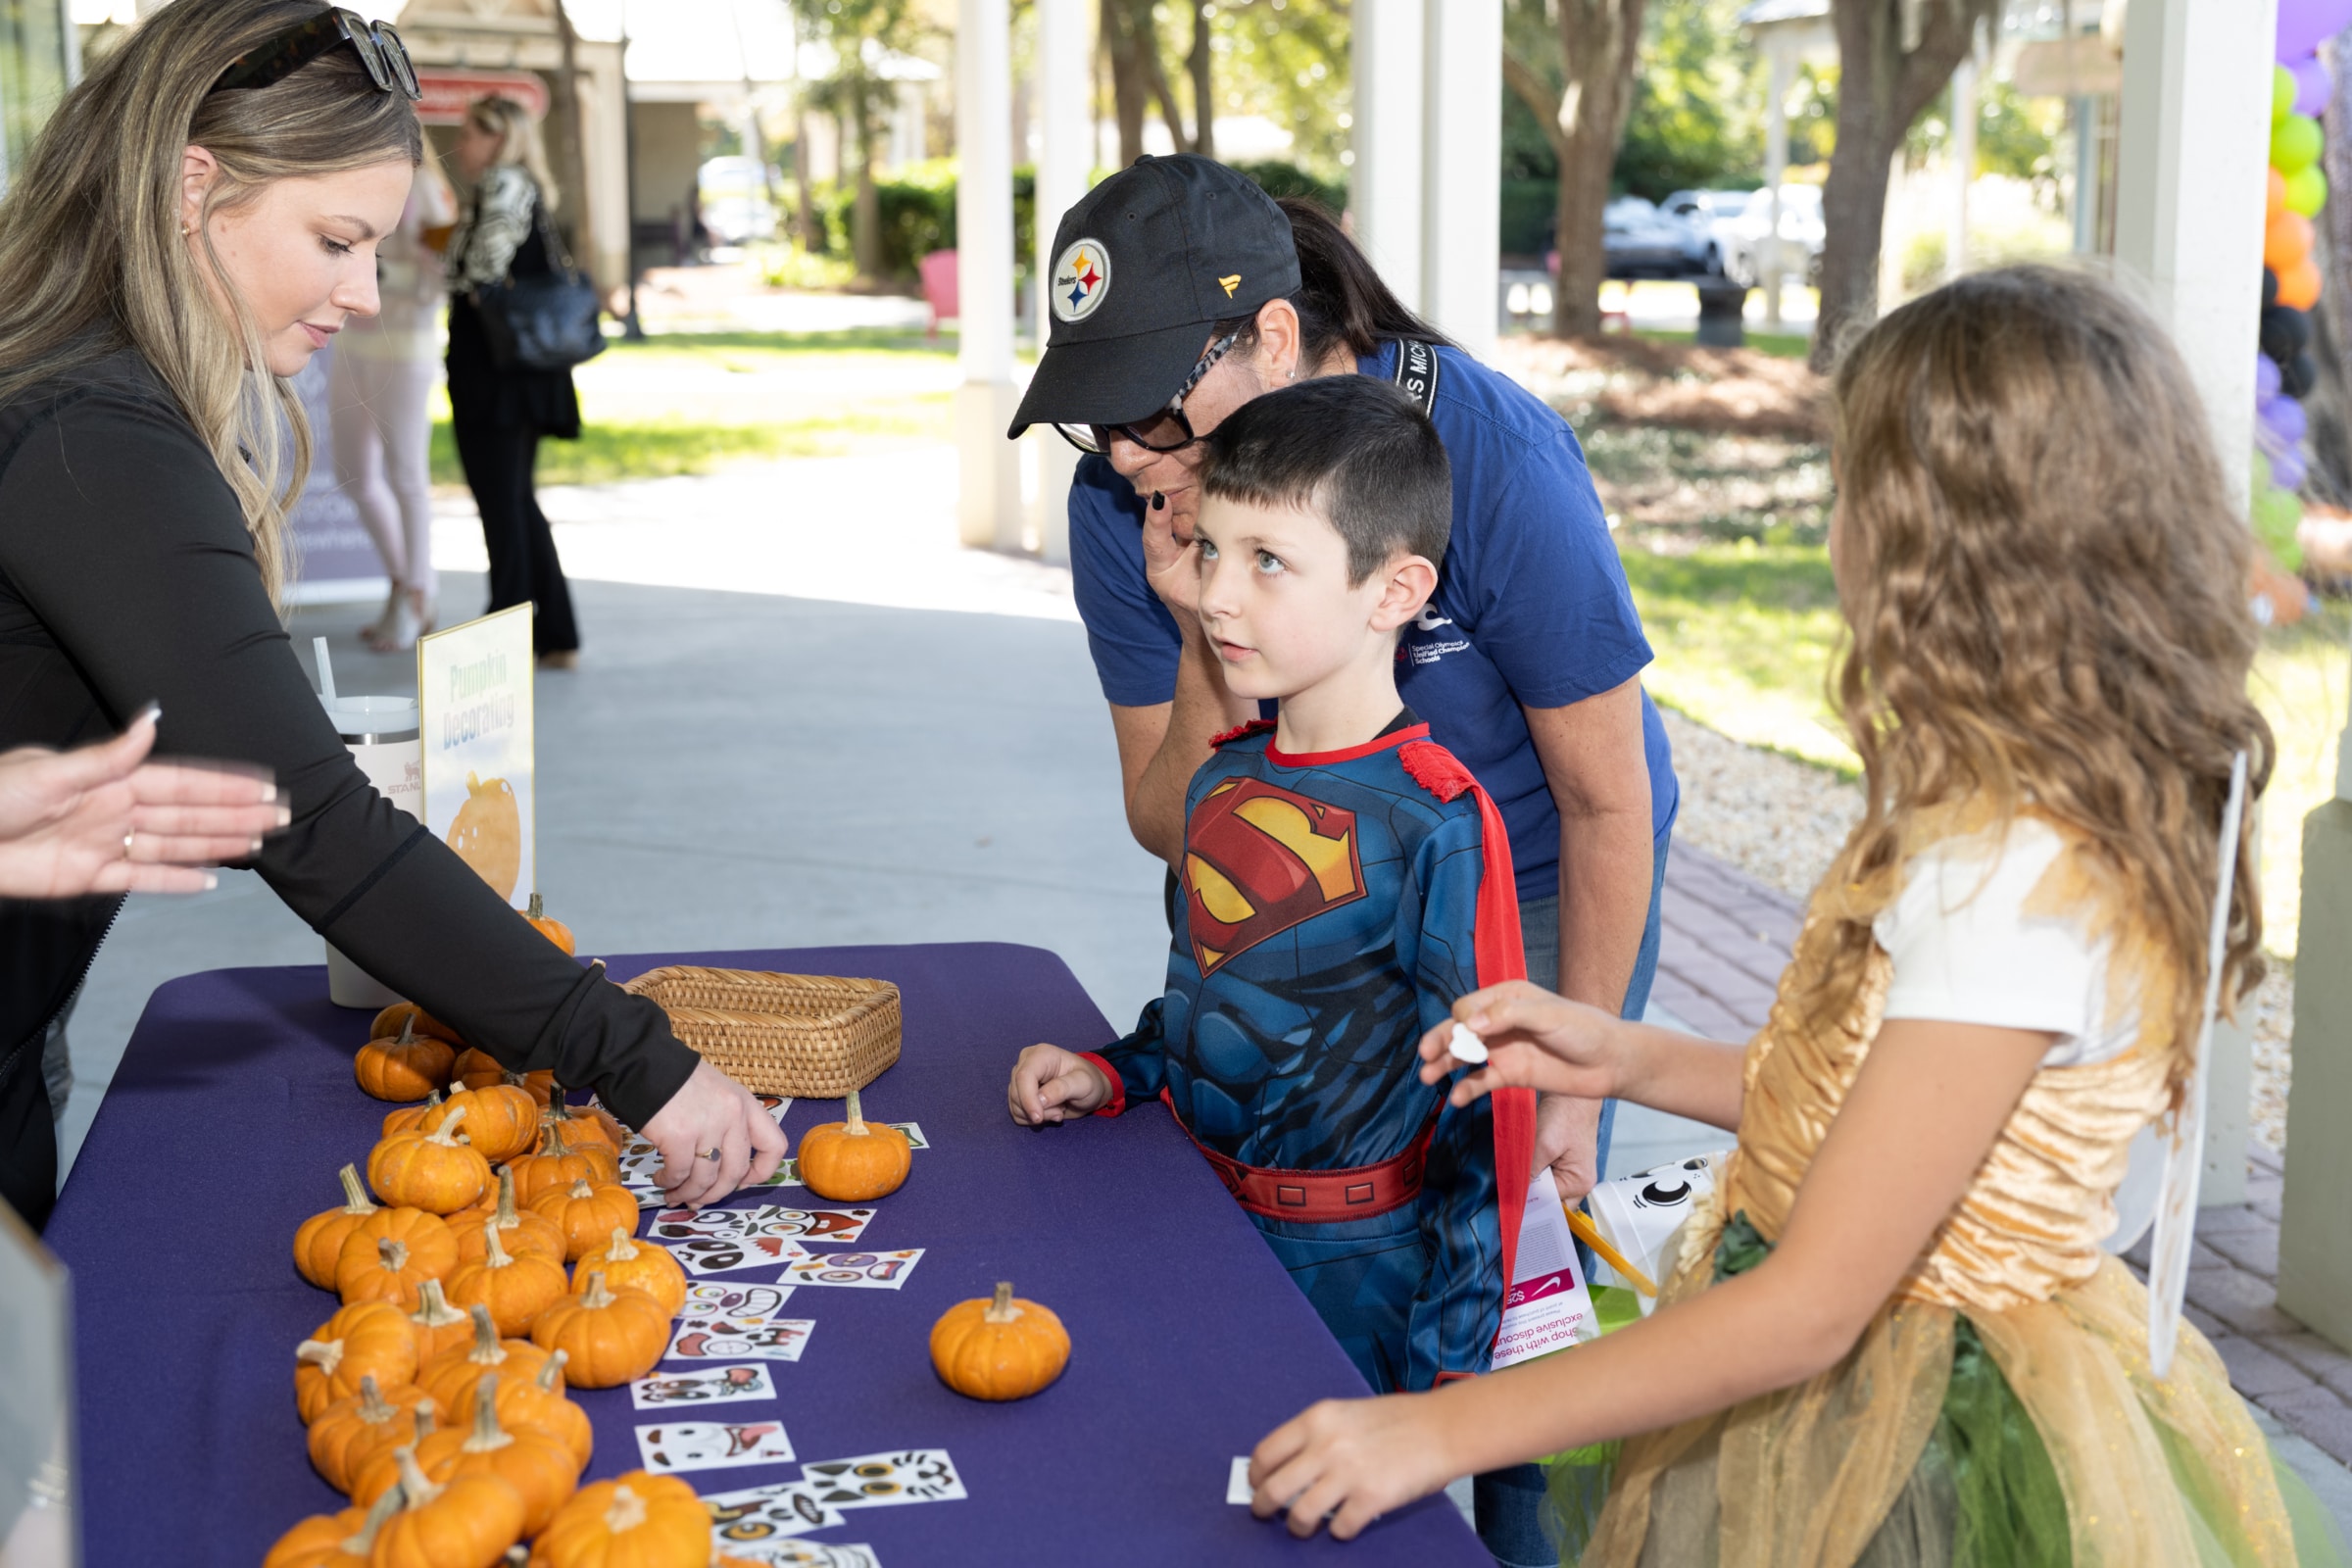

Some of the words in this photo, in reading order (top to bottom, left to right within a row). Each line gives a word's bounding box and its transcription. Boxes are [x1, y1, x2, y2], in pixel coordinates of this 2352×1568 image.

[1057, 275, 1077, 286] Steelers
[1412, 642, 1434, 653] Special
[1435, 640, 1464, 649] Olympics
[1413, 648, 1439, 659] Unified
[1415, 655, 1441, 664] Schools
[450, 648, 507, 704] Pumpkin
[443, 691, 514, 751] Decorating
[1536, 1313, 1583, 1333] exclusive
[1551, 1326, 1579, 1341] Shop
[1526, 1337, 1549, 1350] with
[1494, 1346, 1525, 1359] these
